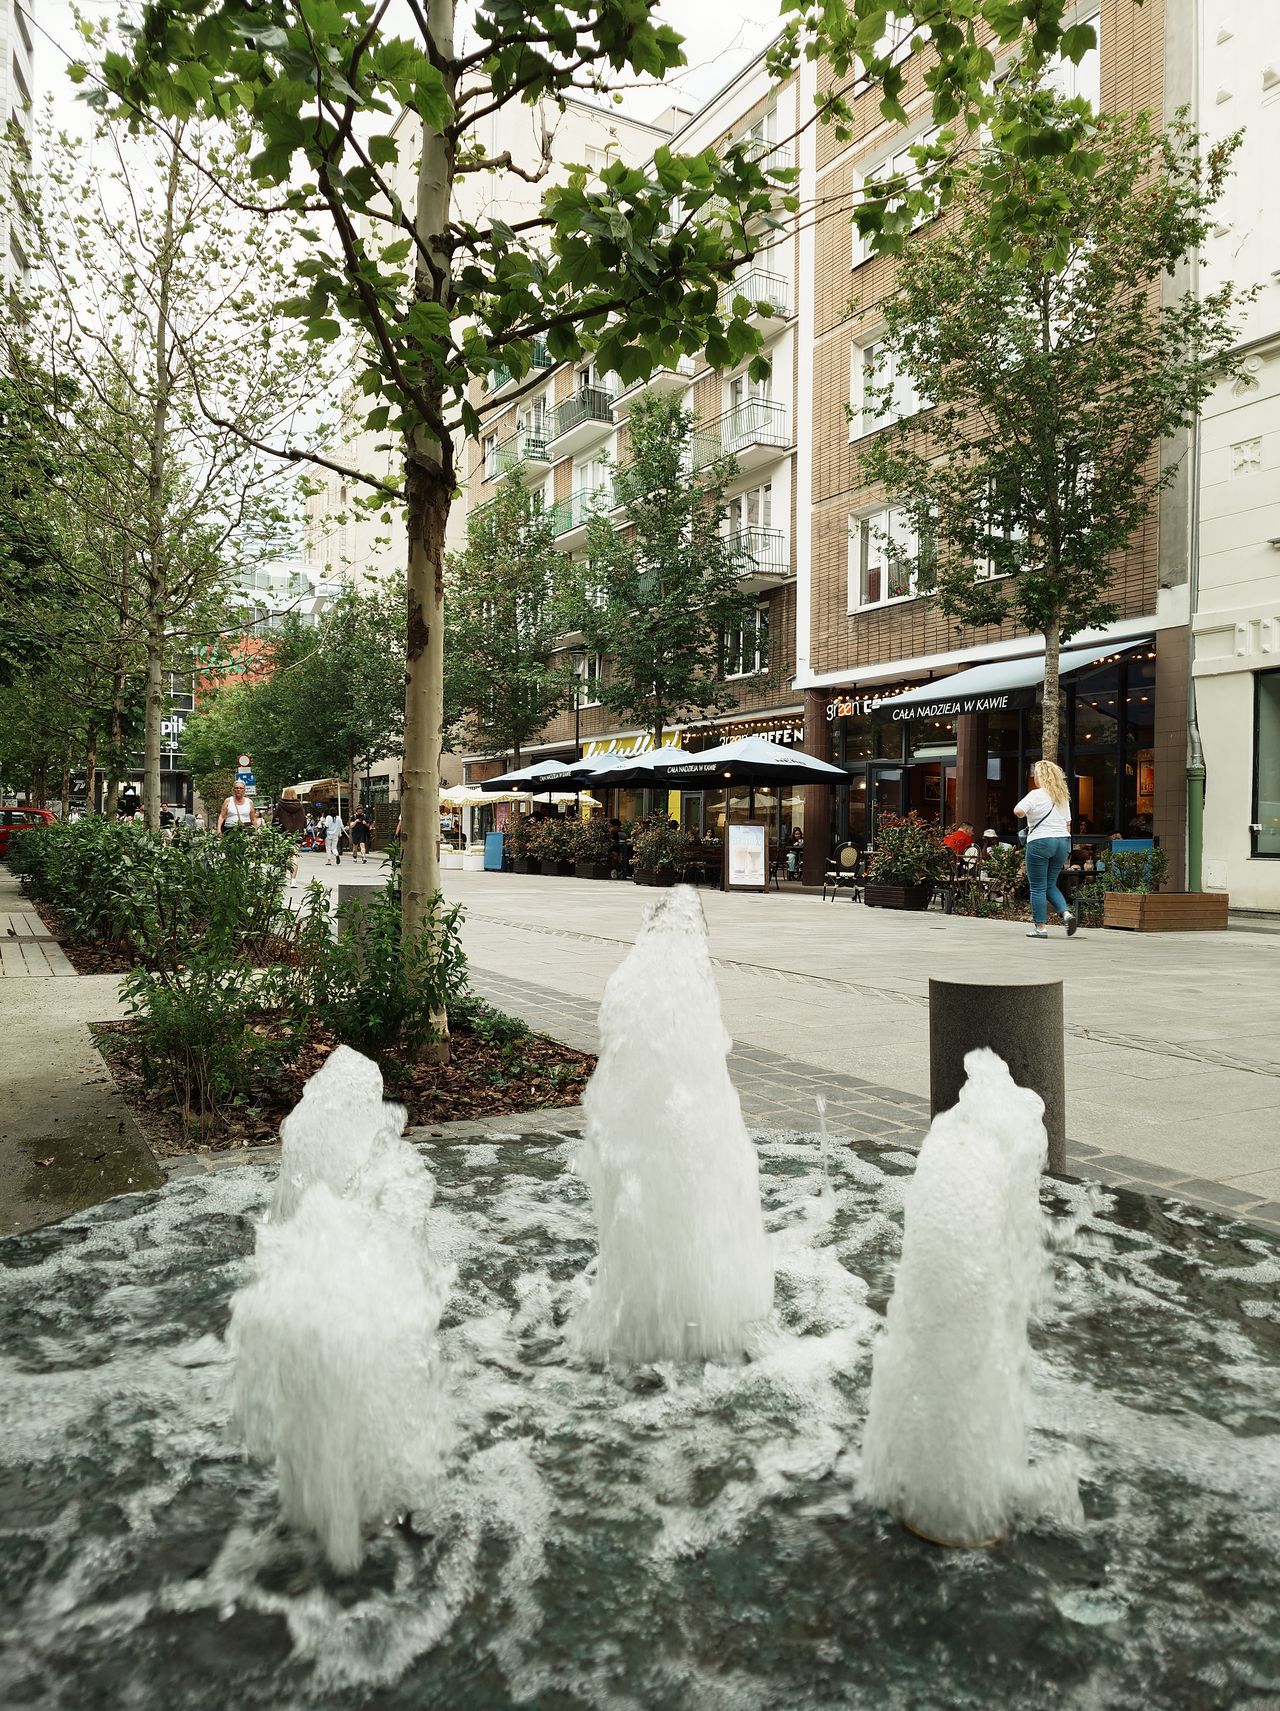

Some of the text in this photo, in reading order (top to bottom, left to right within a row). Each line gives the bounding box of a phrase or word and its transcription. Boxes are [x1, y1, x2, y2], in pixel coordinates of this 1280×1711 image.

[826, 701, 860, 721] green
[892, 696, 1008, 721] CAŁA NADZIEJA W KAWIE
